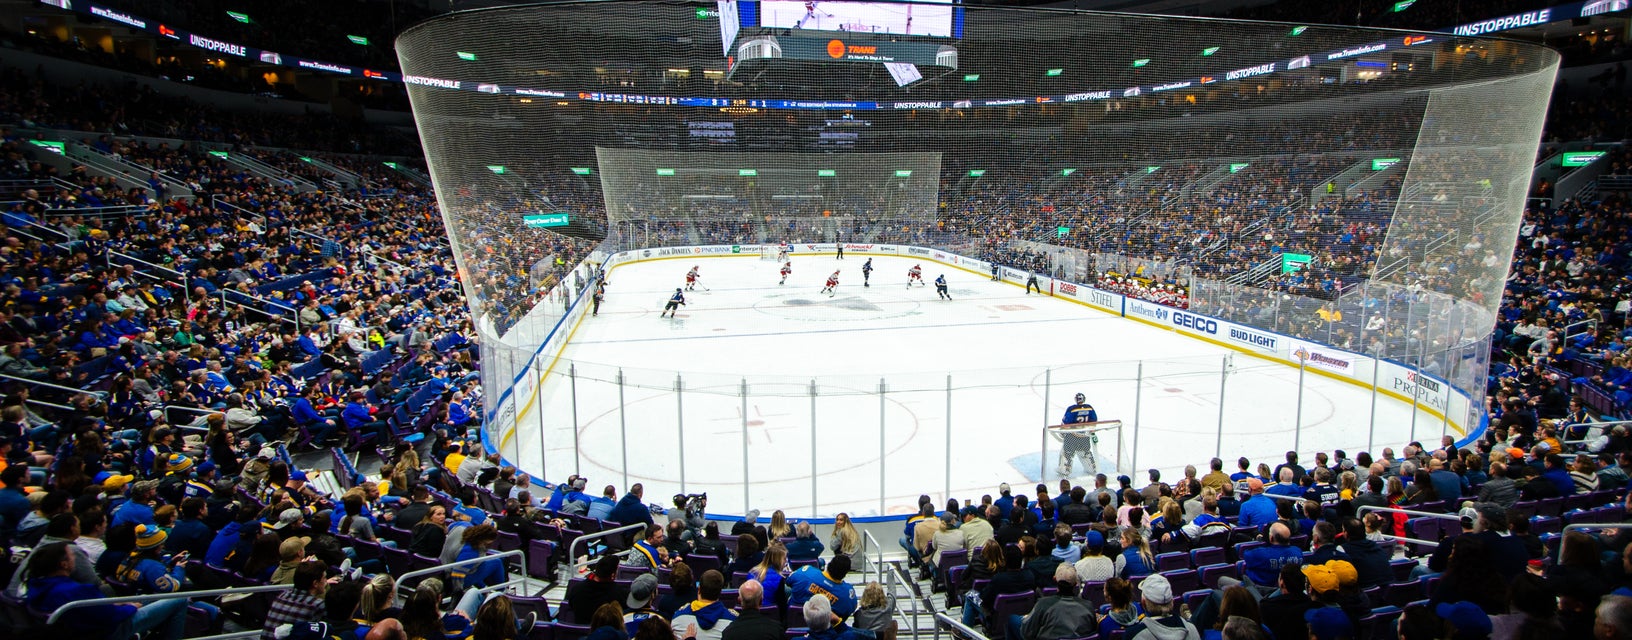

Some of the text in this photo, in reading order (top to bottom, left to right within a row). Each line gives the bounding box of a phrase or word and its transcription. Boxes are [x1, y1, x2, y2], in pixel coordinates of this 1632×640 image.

[1453, 9, 1550, 36] UNSTOPPABLE
[190, 33, 247, 57] UNSTOPPABLE
[848, 46, 877, 54] TRANE
[1328, 43, 1386, 60] www.TraneInfo.com
[299, 61, 351, 74] www.TraneInfo.com
[1226, 63, 1275, 80] UNSTOPPABLE
[402, 75, 461, 89] UNSTOPPABLE
[1065, 90, 1111, 101] UNSTOPPABLE
[894, 101, 942, 109] UNSTOPPABLE
[1060, 282, 1077, 292] DOBBS
[1090, 290, 1114, 308] STIFEL
[1129, 302, 1154, 318] Anthem
[1172, 311, 1217, 334] GEICO
[1230, 328, 1276, 349] BUD LIGHT
